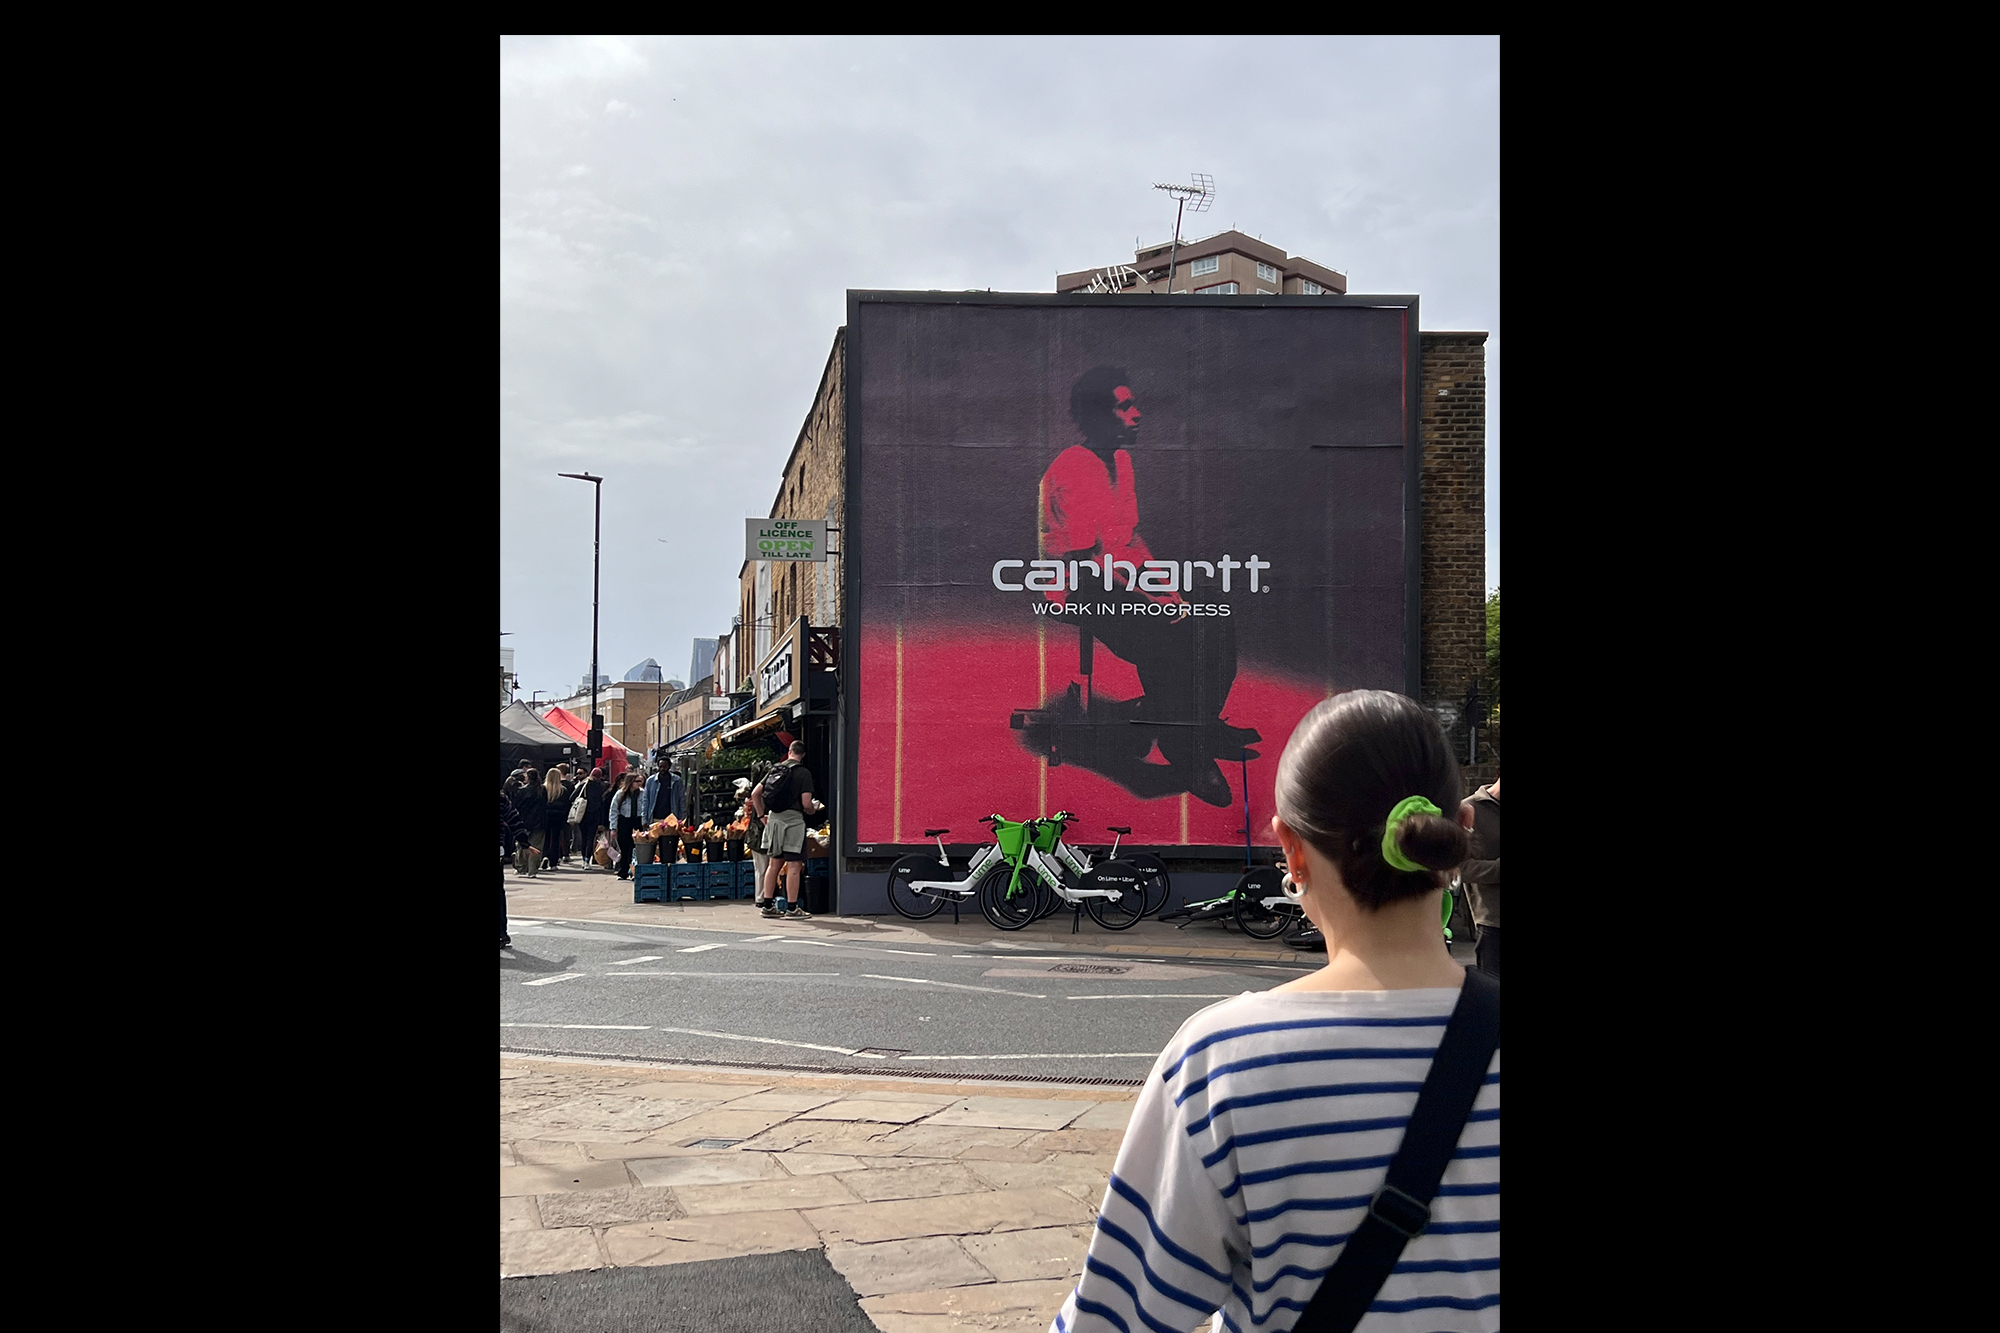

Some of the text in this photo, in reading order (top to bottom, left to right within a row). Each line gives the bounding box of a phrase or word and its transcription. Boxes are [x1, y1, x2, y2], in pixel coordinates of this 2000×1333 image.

[774, 521, 798, 530] OFF
[760, 529, 813, 538] LICENCE
[758, 540, 815, 551] OPEN
[1031, 602, 1232, 617] WORK IN PROGRESS
